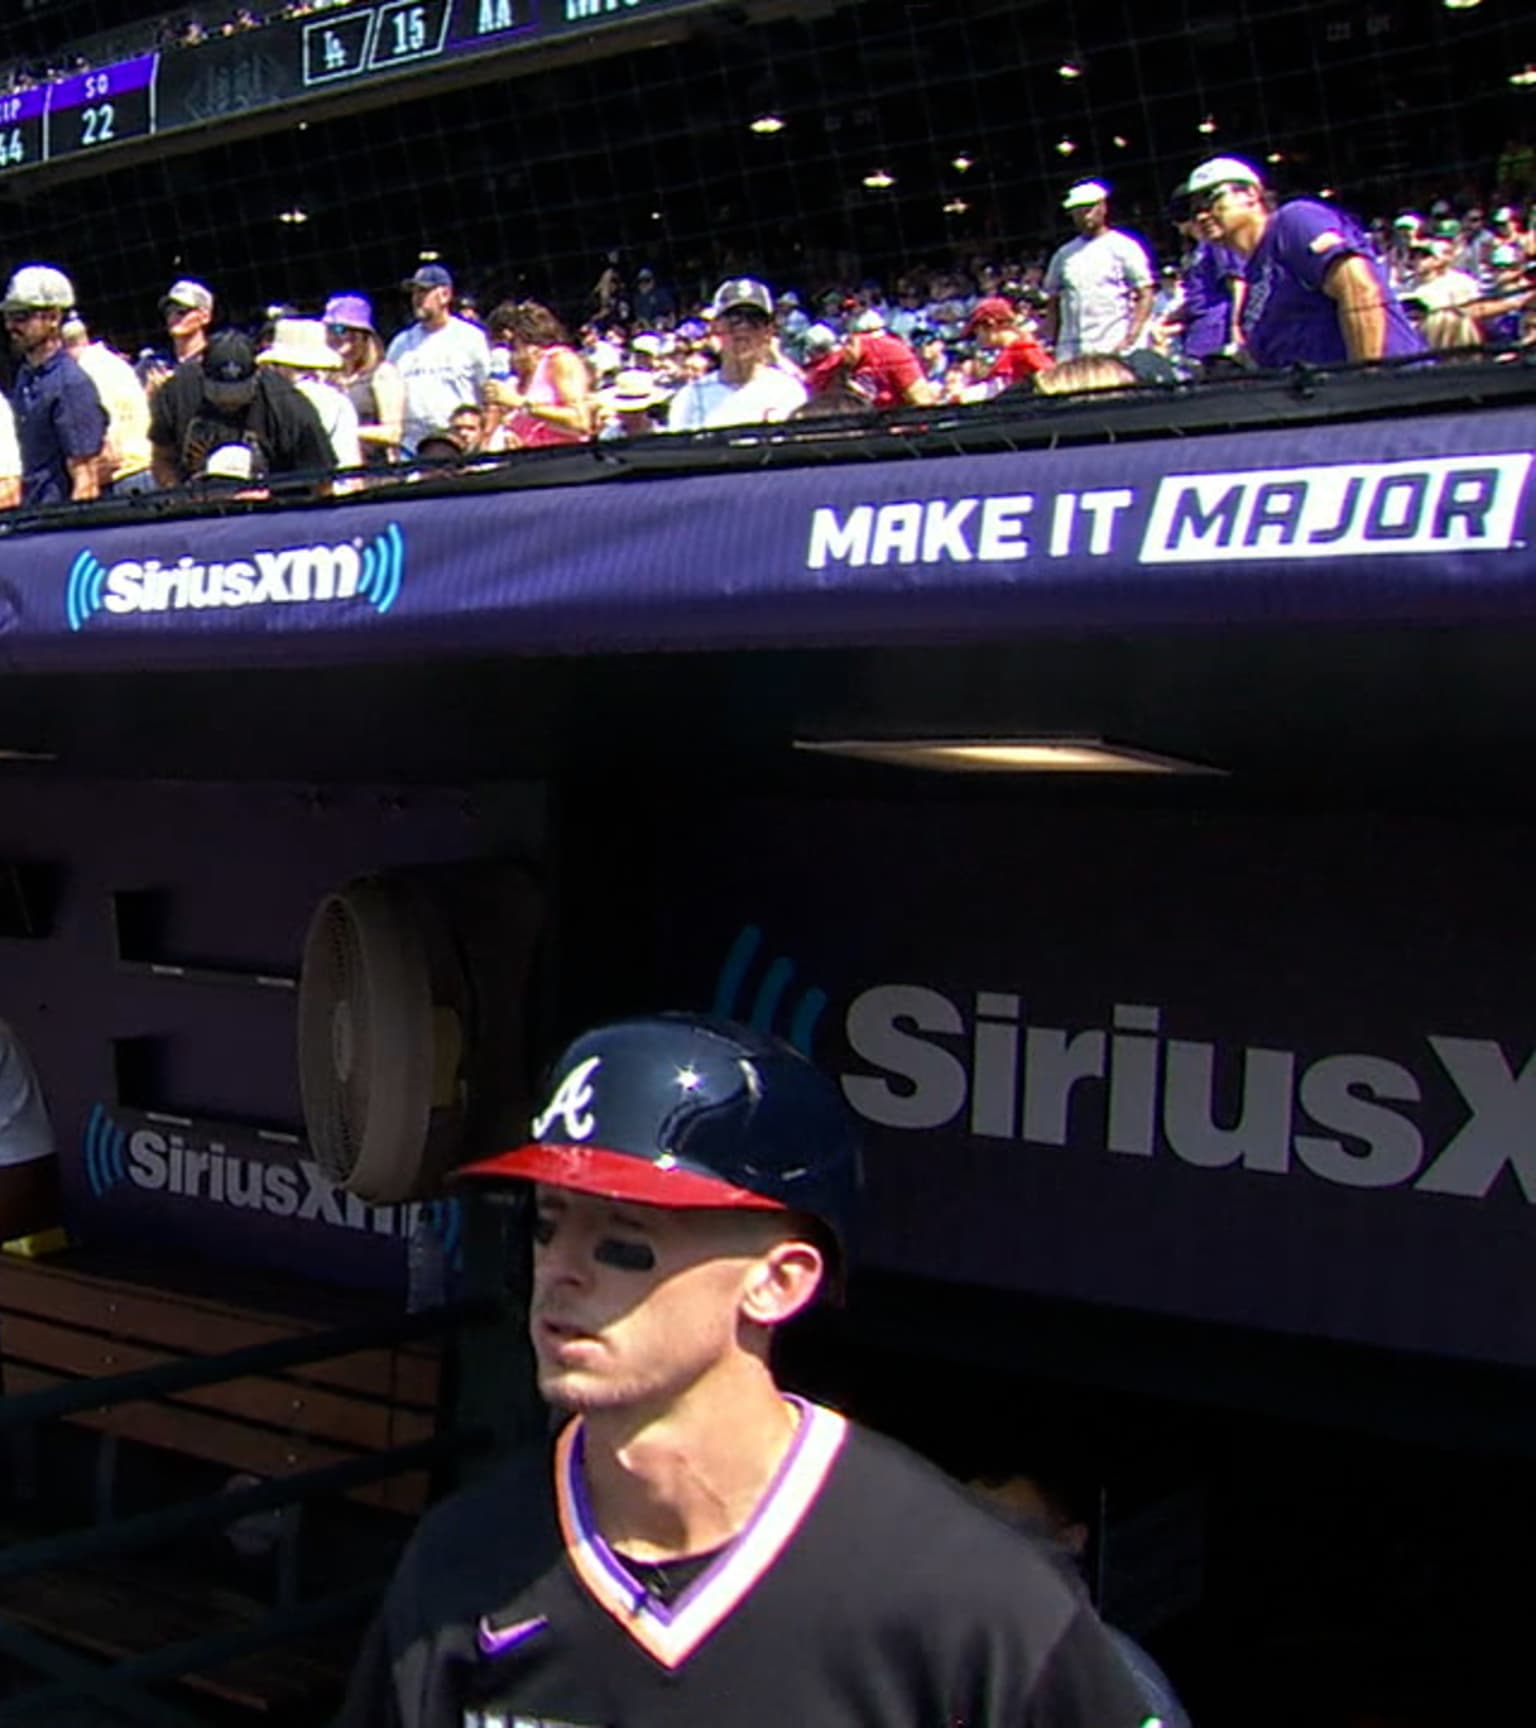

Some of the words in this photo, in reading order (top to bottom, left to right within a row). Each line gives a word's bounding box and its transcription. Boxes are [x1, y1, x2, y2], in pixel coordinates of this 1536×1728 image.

[392, 8, 426, 54] 15
[82, 104, 115, 144] 22
[807, 496, 1034, 570] MAKE
[1050, 490, 1133, 558] IT
[1164, 468, 1500, 549] MAJOR
[532, 1056, 600, 1140] A
[840, 984, 1536, 1203] SiriusX
